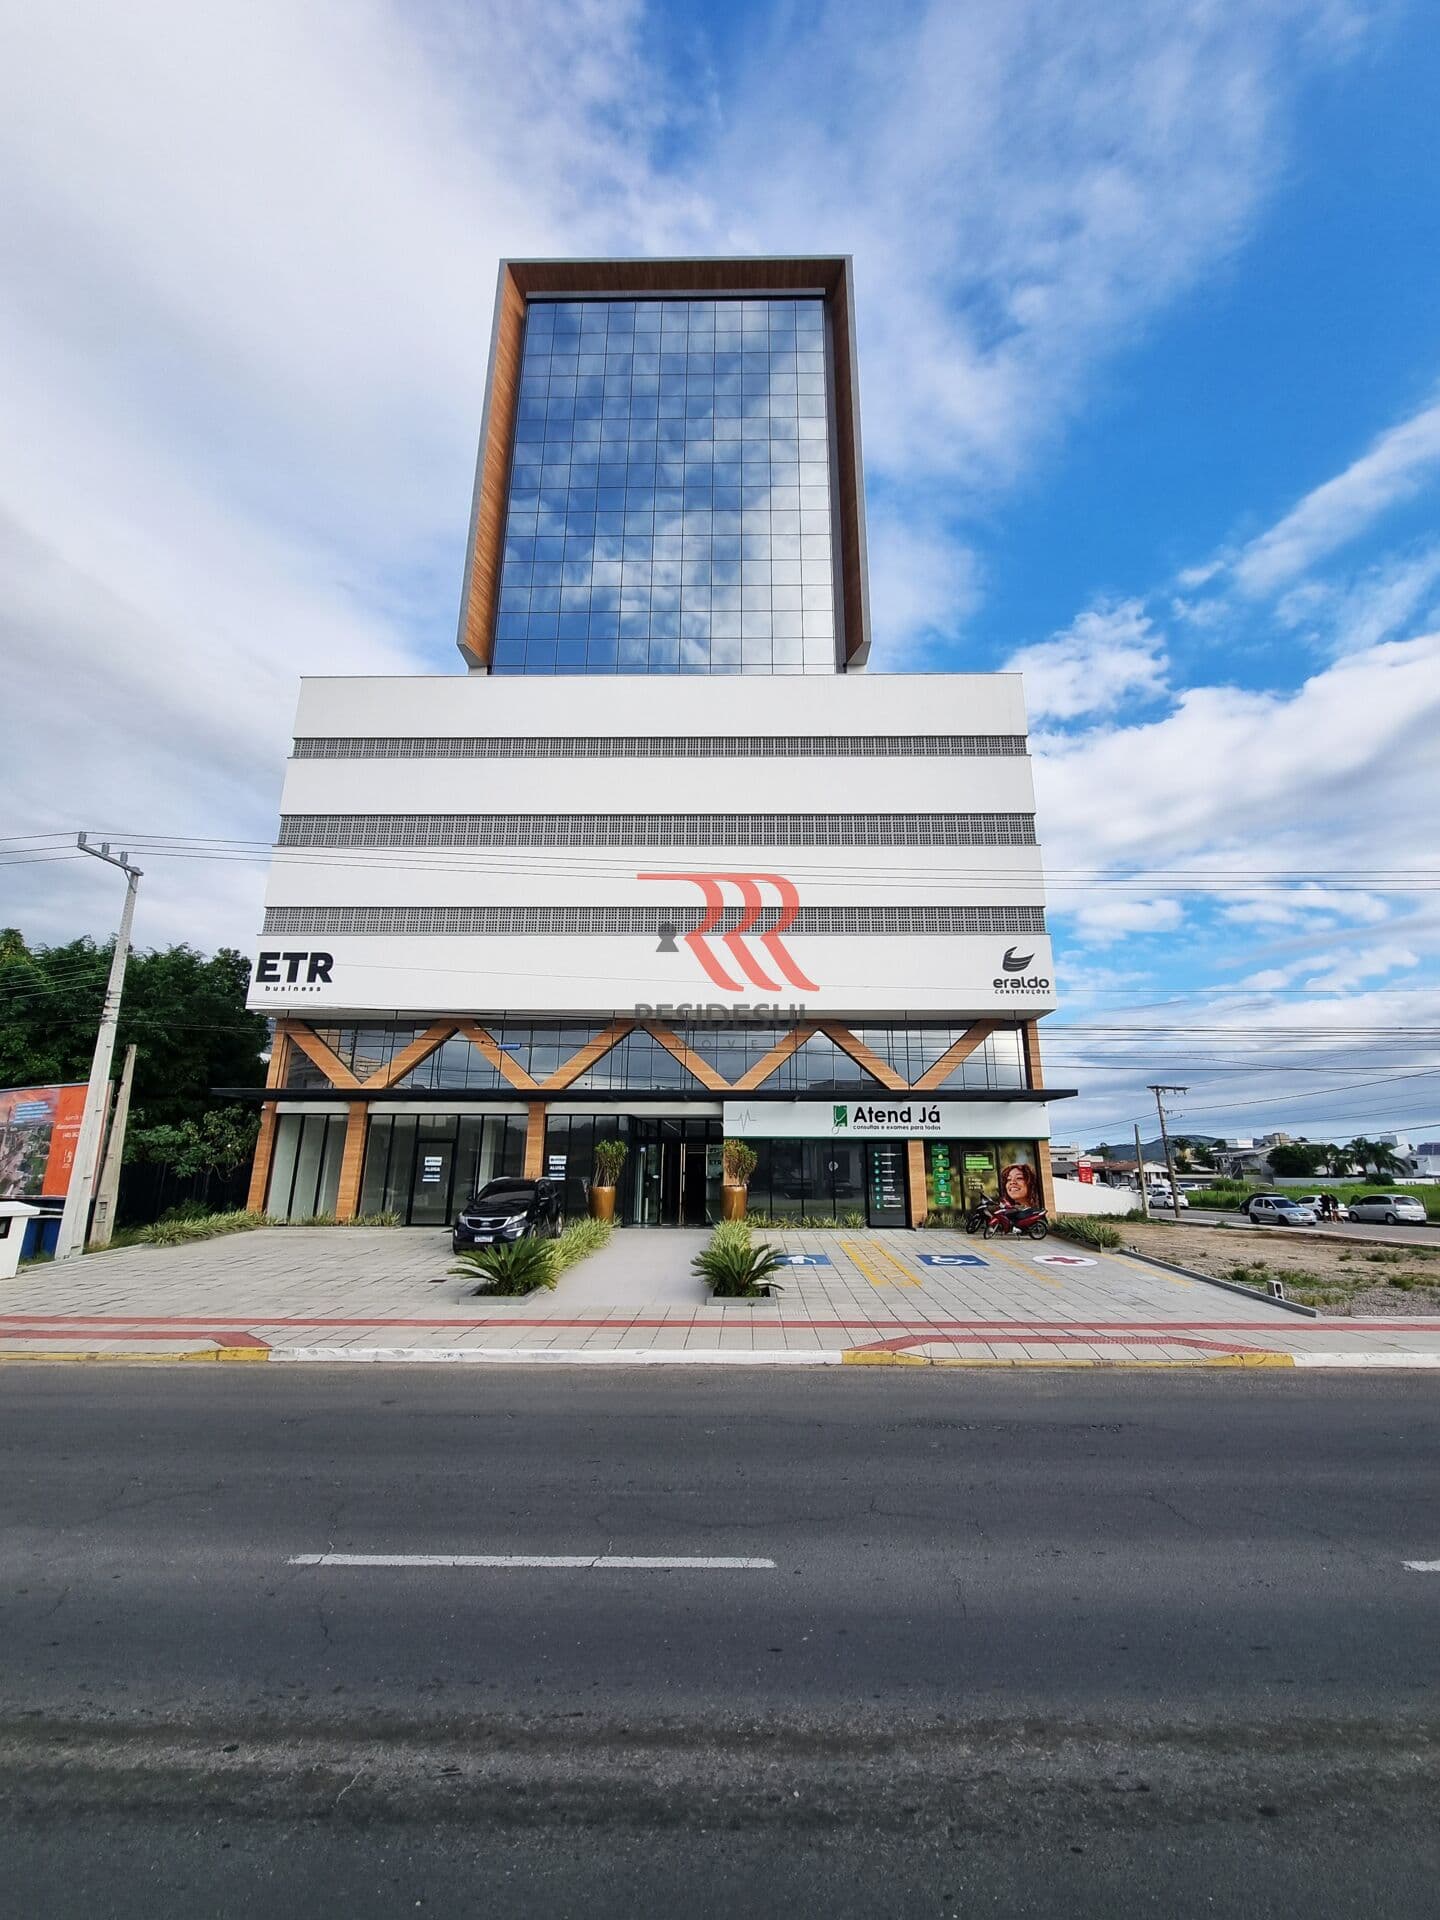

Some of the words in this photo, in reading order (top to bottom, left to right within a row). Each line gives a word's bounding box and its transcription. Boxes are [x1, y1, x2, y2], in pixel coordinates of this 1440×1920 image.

[256, 952, 334, 983] ETR
[993, 976, 1049, 988] eraldo
[853, 1106, 912, 1123] Atend
[918, 1105, 940, 1123] Já
